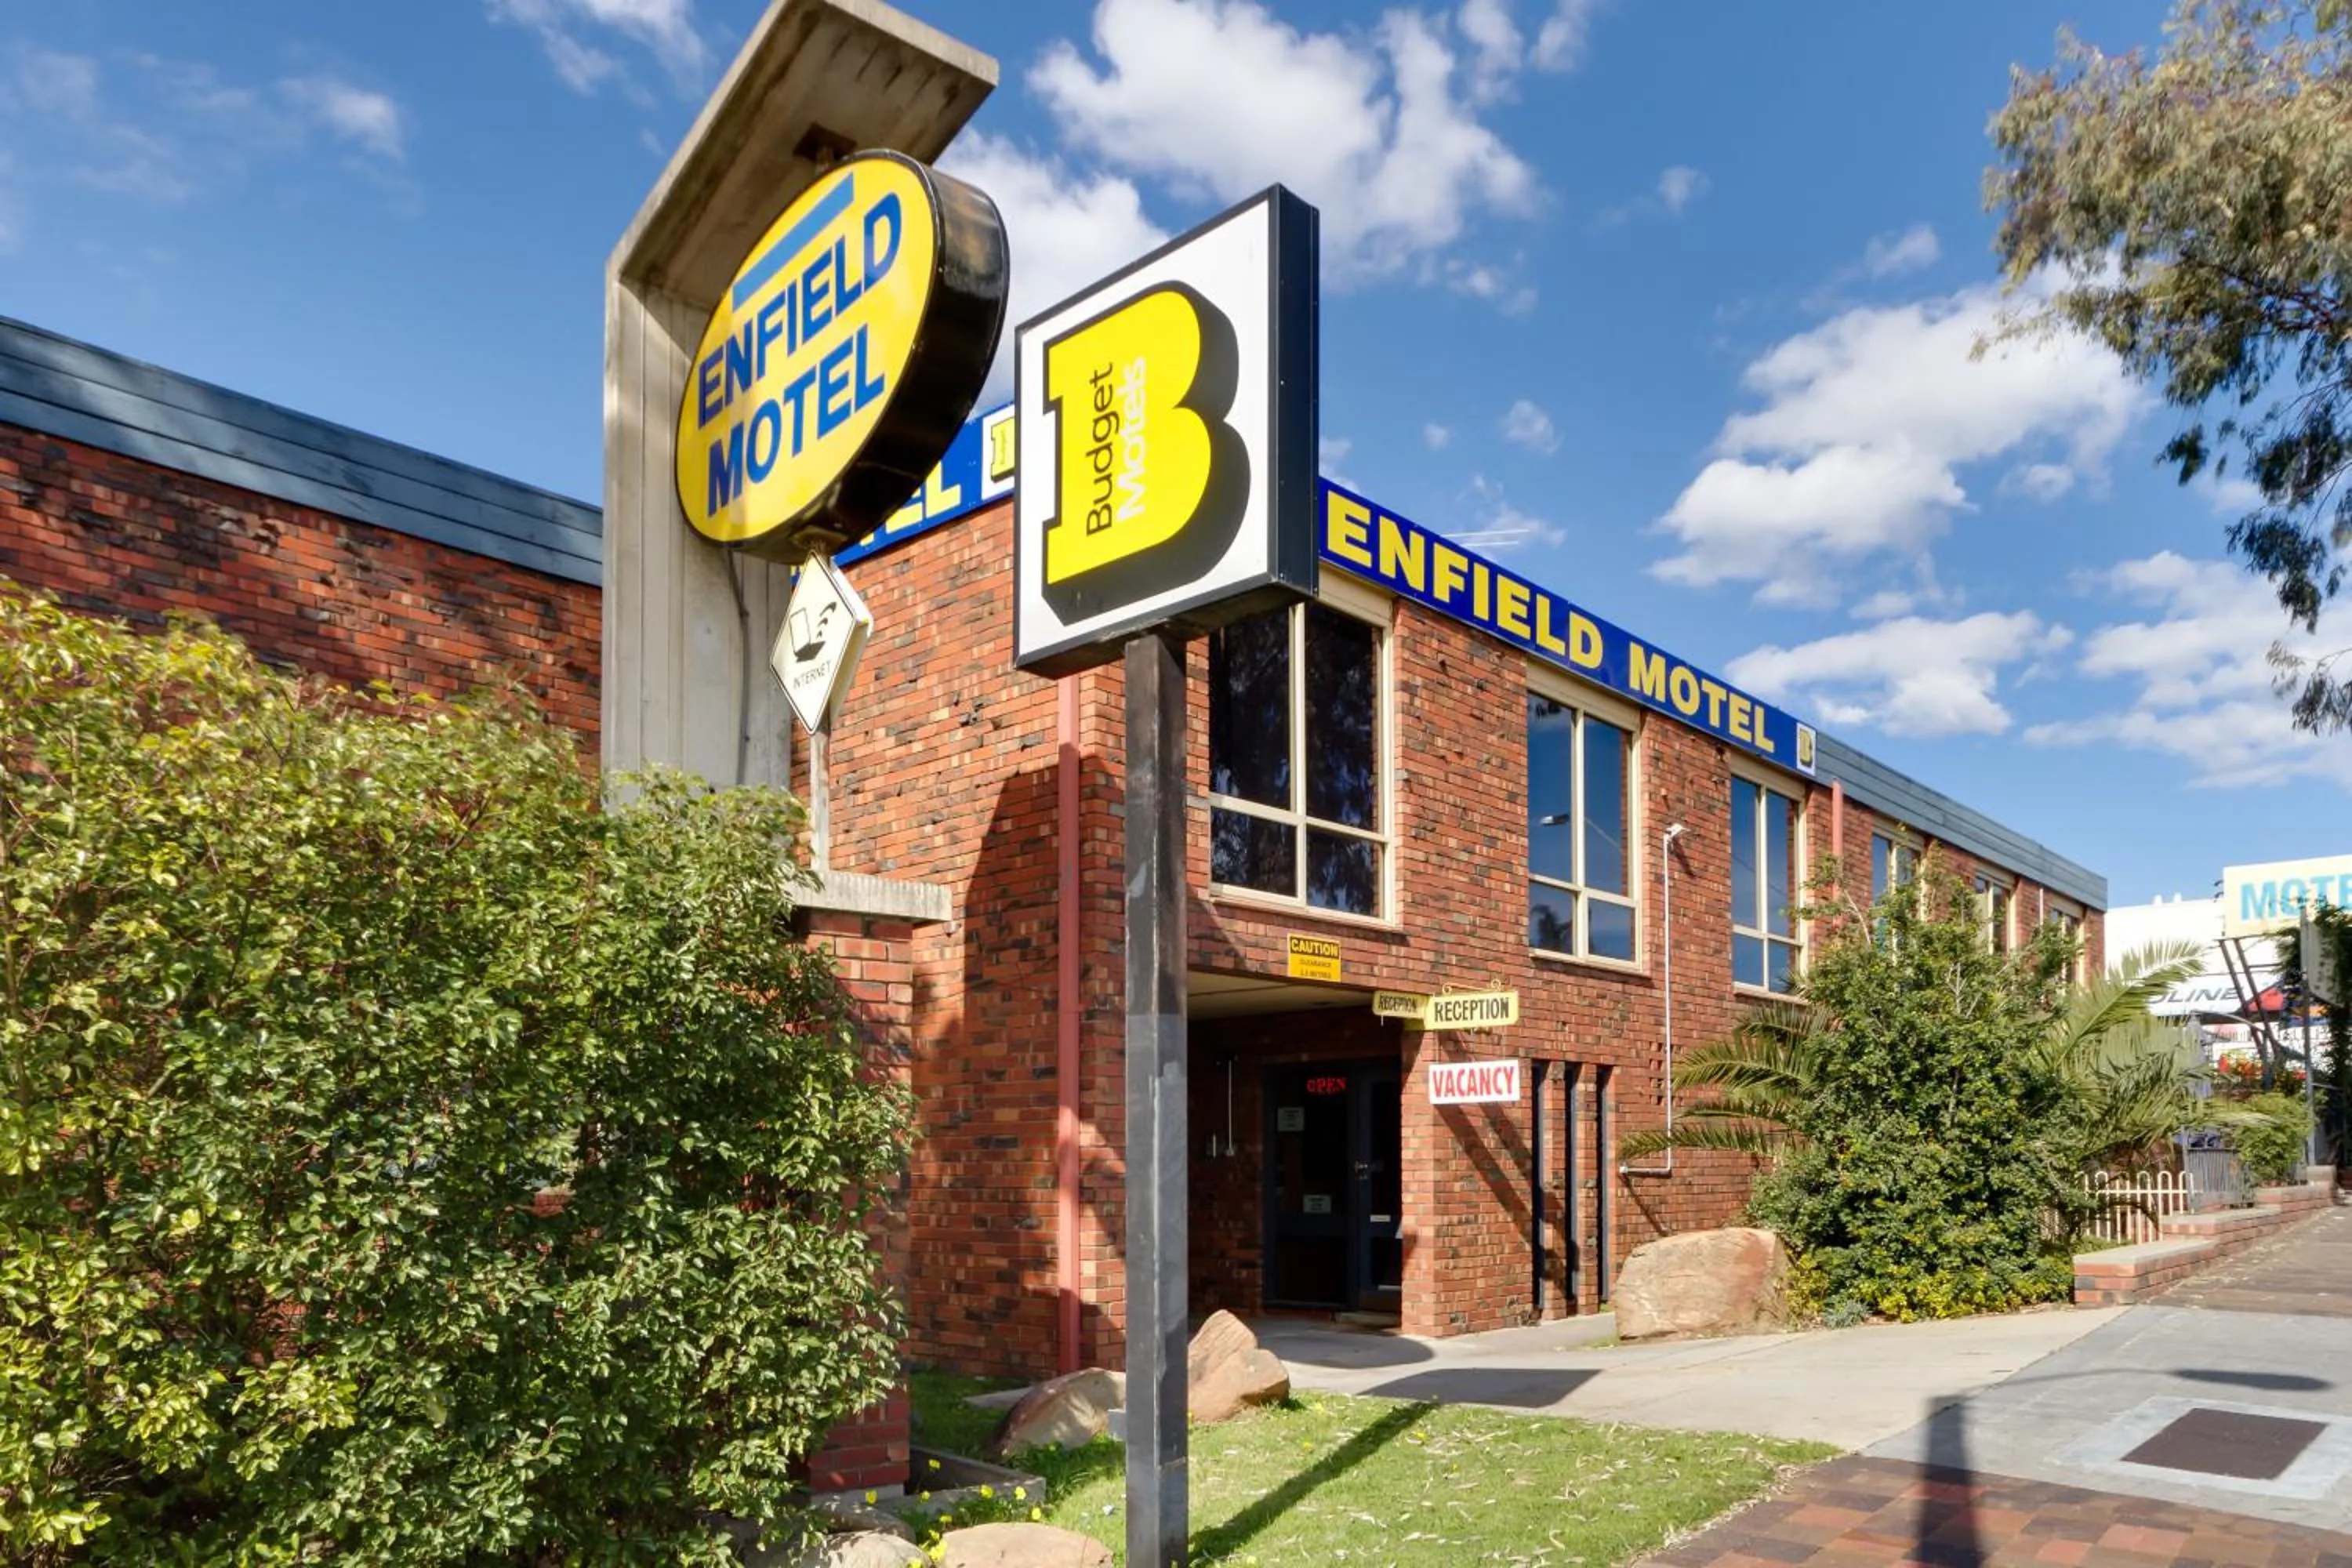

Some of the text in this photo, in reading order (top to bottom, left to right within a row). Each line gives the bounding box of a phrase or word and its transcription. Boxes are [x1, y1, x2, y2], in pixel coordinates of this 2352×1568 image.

[698, 192, 902, 430] ENFIELD
[708, 323, 885, 517] MOTEL
[1086, 362, 1119, 536] Budget
[1116, 356, 1146, 522] Motels
[1327, 489, 1774, 753] ENFIELD MOTEL
[793, 660, 832, 690] INTERNET
[1291, 939, 1338, 956] CAUTION
[1378, 994, 1417, 1013] RECEPTION
[1434, 996, 1509, 1022] RECEPTION
[1307, 1076, 1347, 1094] OPEN
[1432, 1066, 1515, 1098] VACANCY
